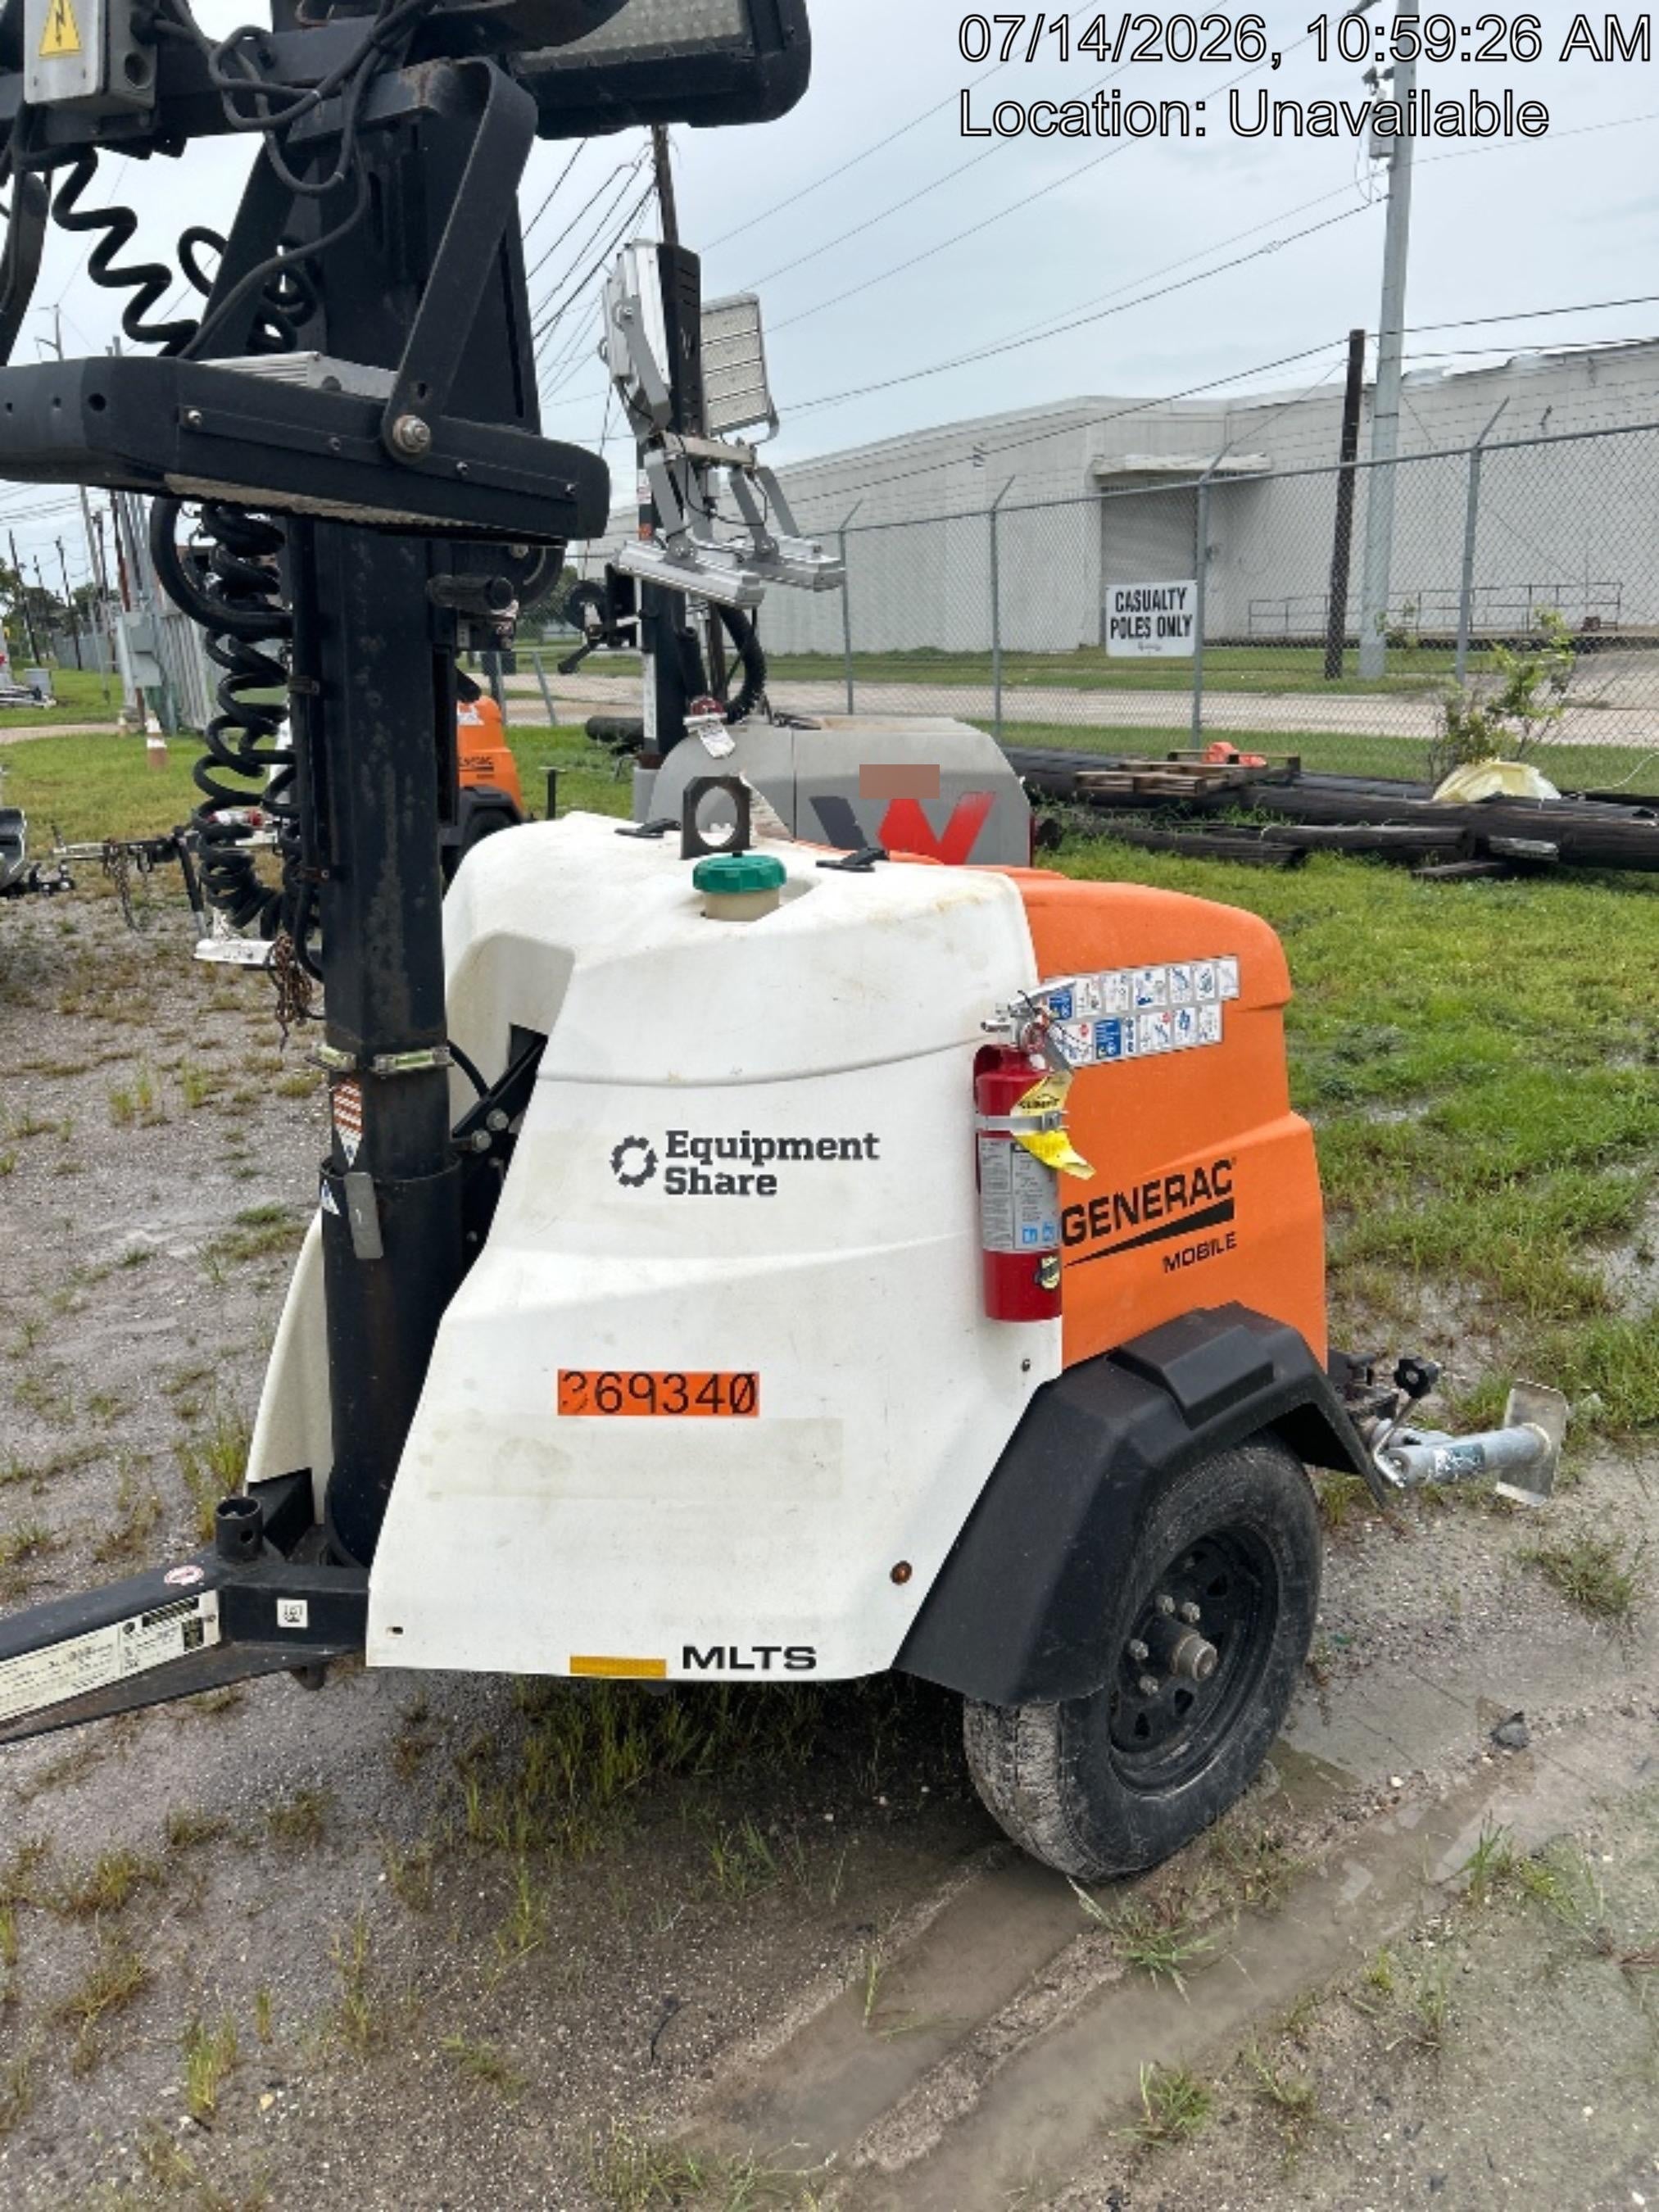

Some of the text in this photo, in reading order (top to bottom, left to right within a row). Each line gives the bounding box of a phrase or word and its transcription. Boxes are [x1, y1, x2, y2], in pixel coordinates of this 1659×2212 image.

[1115, 587, 1187, 613] CASUALTY
[1110, 614, 1193, 640] POLES ONLY
[665, 1130, 880, 1166] Equipment
[664, 1167, 777, 1195] Share
[1062, 1159, 1232, 1247] GENERAC
[1163, 1231, 1237, 1273] MOBILE
[682, 1646, 817, 1670] MLTS
